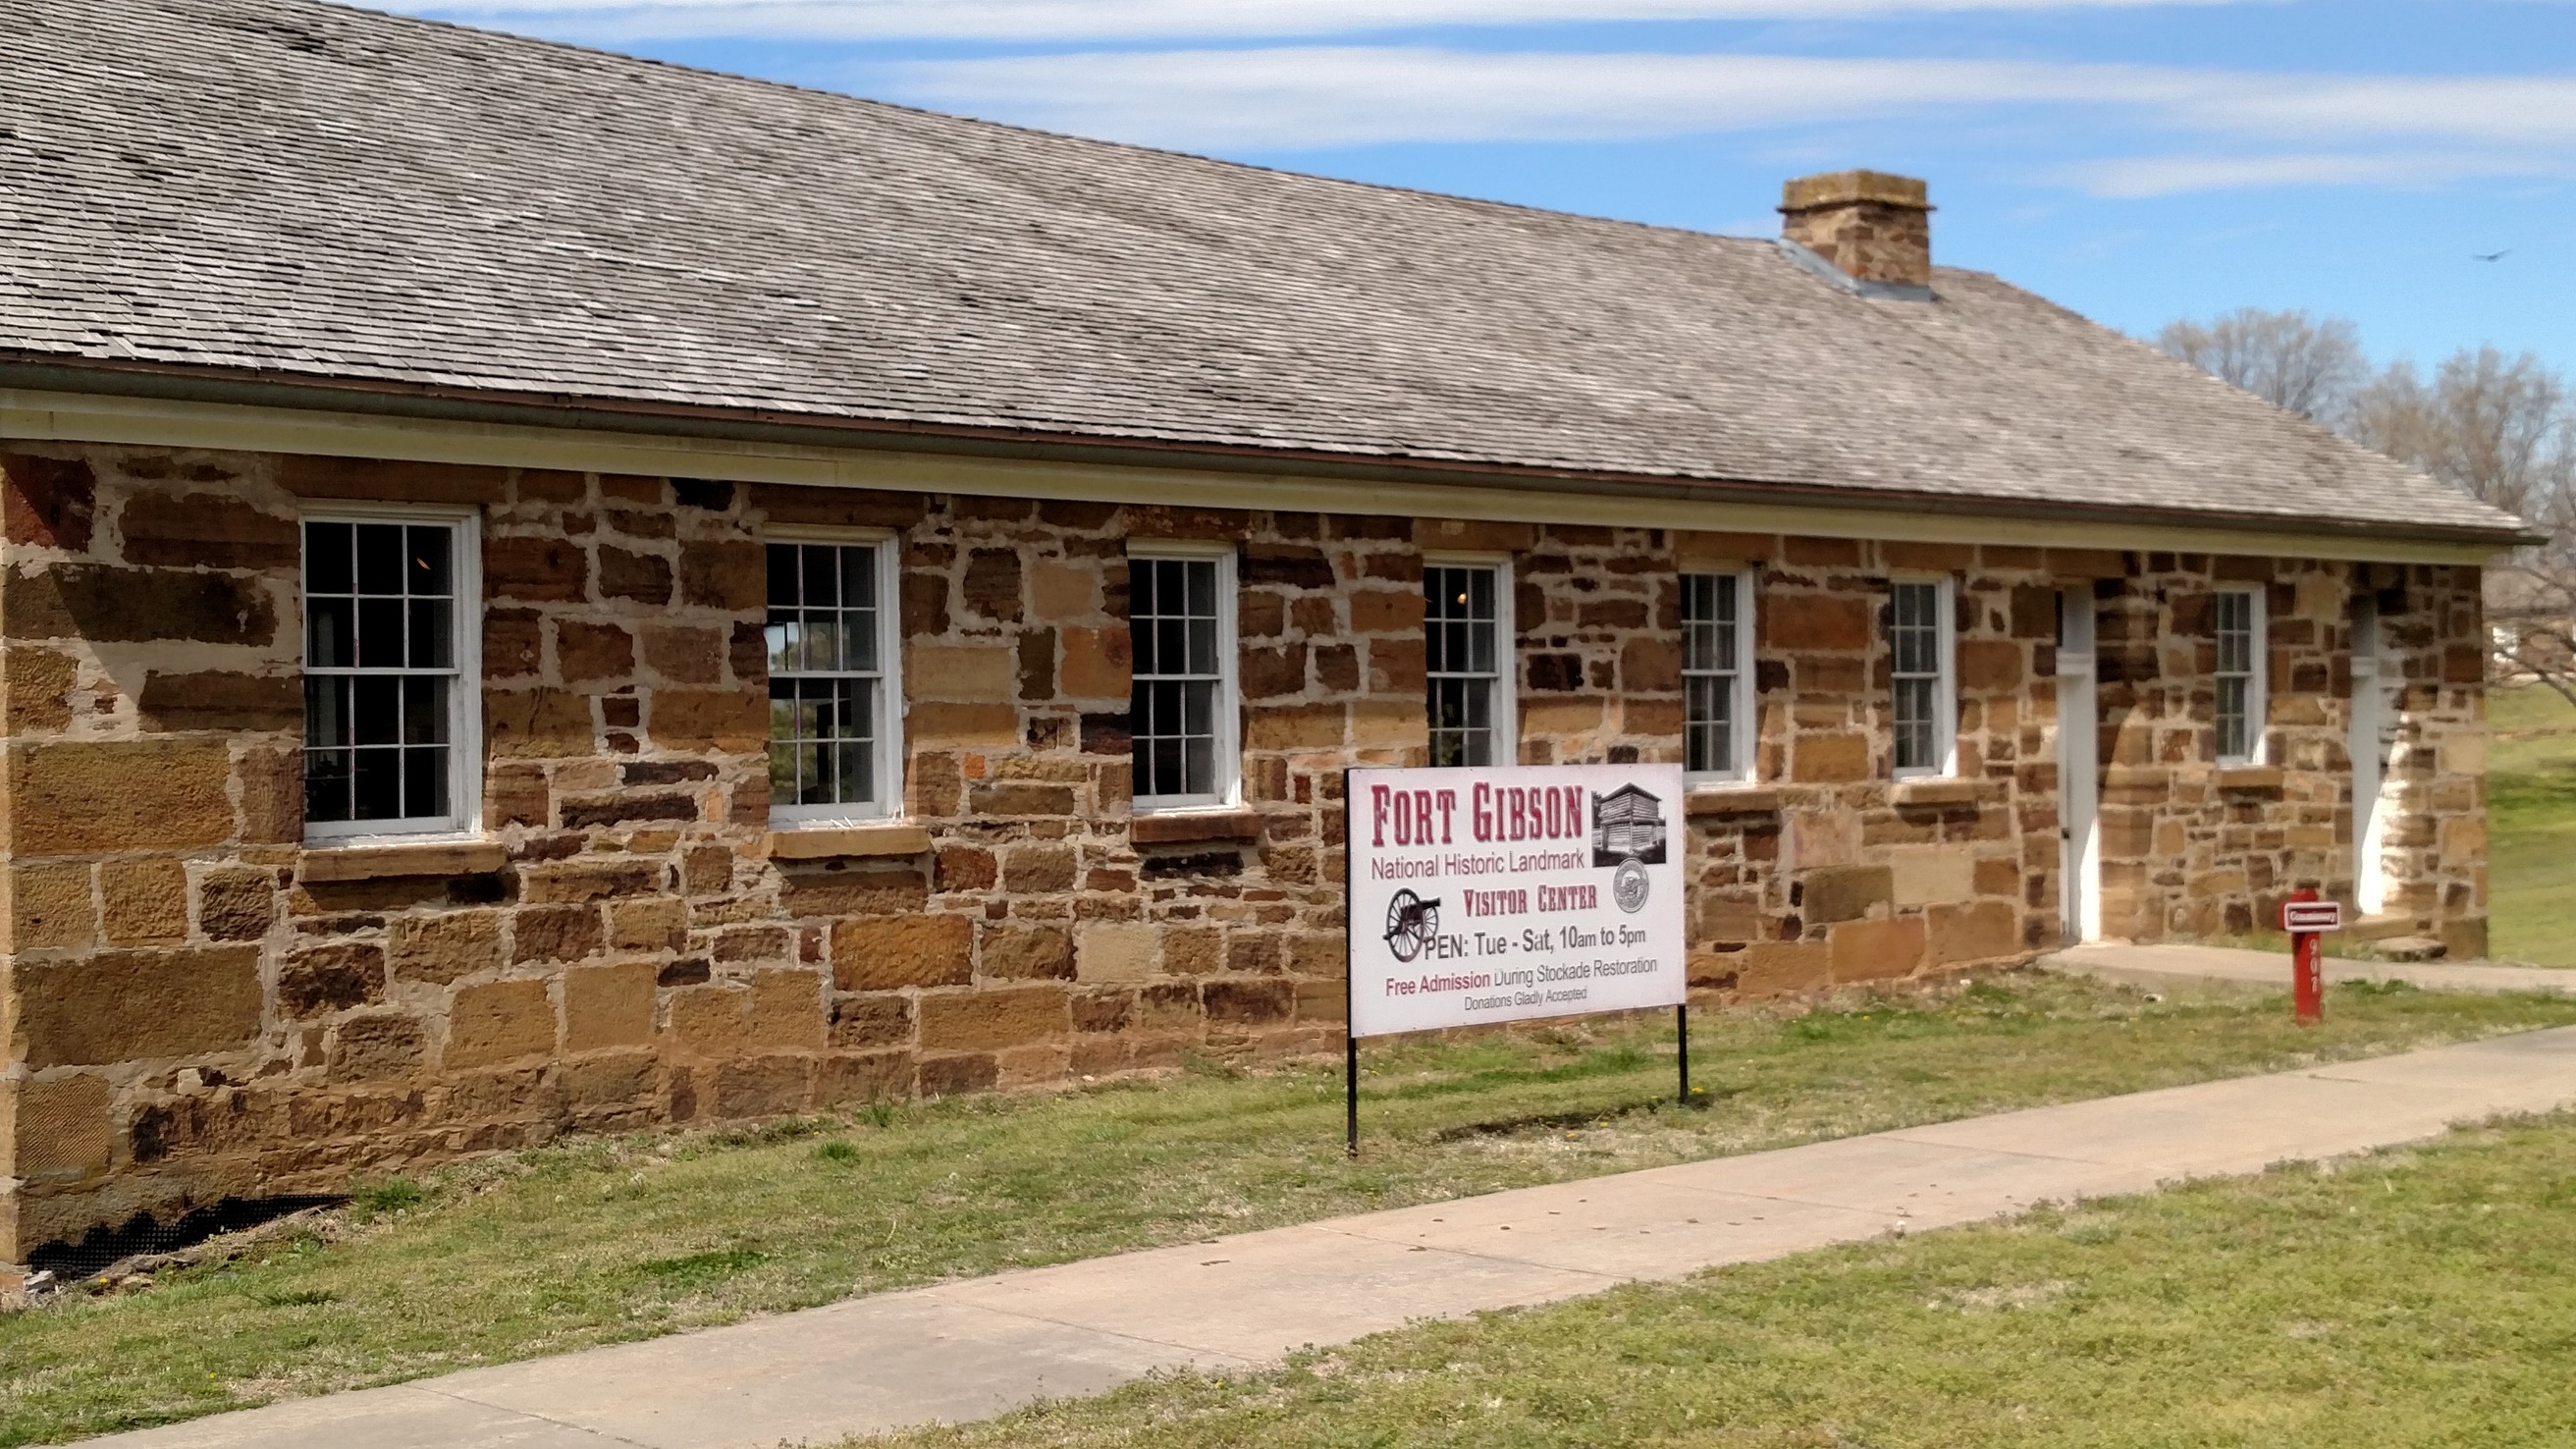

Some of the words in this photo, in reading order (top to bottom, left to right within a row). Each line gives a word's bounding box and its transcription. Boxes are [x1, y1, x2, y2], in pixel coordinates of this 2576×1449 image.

[1371, 784, 1456, 847] FORT
[1474, 781, 1583, 842] GIBSON
[1371, 854, 1438, 880] National
[1445, 851, 1504, 875] Historic
[1509, 847, 1584, 872] Landmark
[1463, 888, 1528, 917] VISITOR
[1537, 885, 1597, 912] CENTER
[1474, 932, 1507, 955] Tue
[1523, 928, 1554, 954] Sat,
[1559, 925, 1596, 948] 10am
[1600, 927, 1615, 945] to
[1618, 924, 1646, 947] 5pm
[1385, 978, 1416, 996] Free
[1420, 971, 1490, 993] Admission
[1494, 967, 1533, 988] During
[1536, 961, 1590, 983] Stockade
[1593, 957, 1658, 977] Restoration
[1465, 994, 1512, 1010] Donations
[1514, 990, 1542, 1006] Gladly
[1545, 987, 1587, 1003] Accepted
